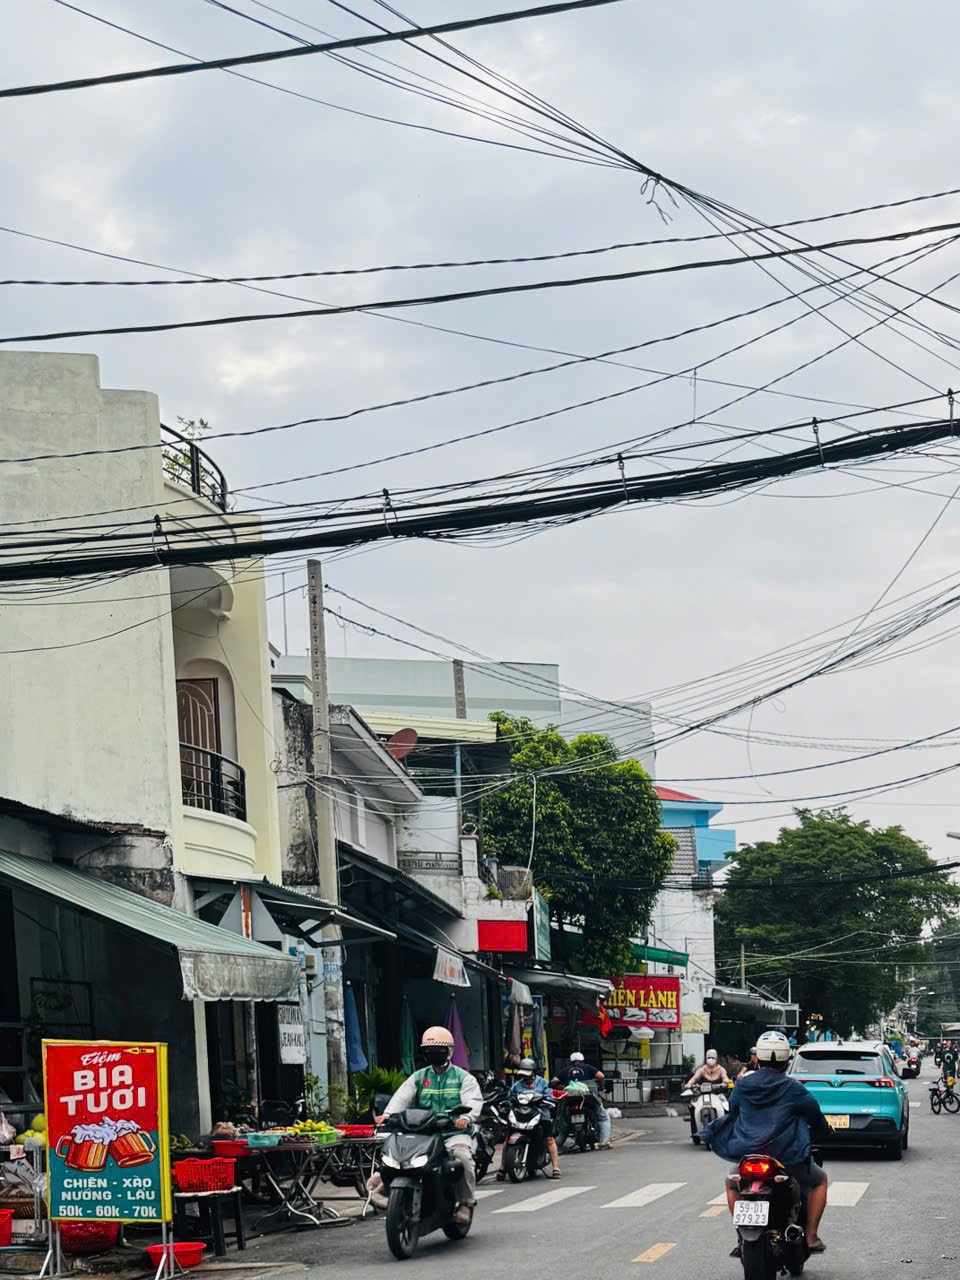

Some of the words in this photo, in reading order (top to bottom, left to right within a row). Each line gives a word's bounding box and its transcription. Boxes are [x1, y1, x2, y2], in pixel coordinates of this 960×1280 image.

[640, 986, 677, 1008] LÀNH
[81, 1051, 122, 1066] Tiệm
[73, 1065, 133, 1091] BIA
[60, 1086, 146, 1116] TƯƠI
[63, 1177, 108, 1188] CHIÊN
[122, 1175, 152, 1188] XÀO
[61, 1188, 112, 1201] NƯỚNG
[59, 1205, 83, 1217] 50k
[96, 1206, 120, 1217] 60k
[132, 1206, 157, 1217] 70k
[735, 1213, 767, 1225] 979.23
